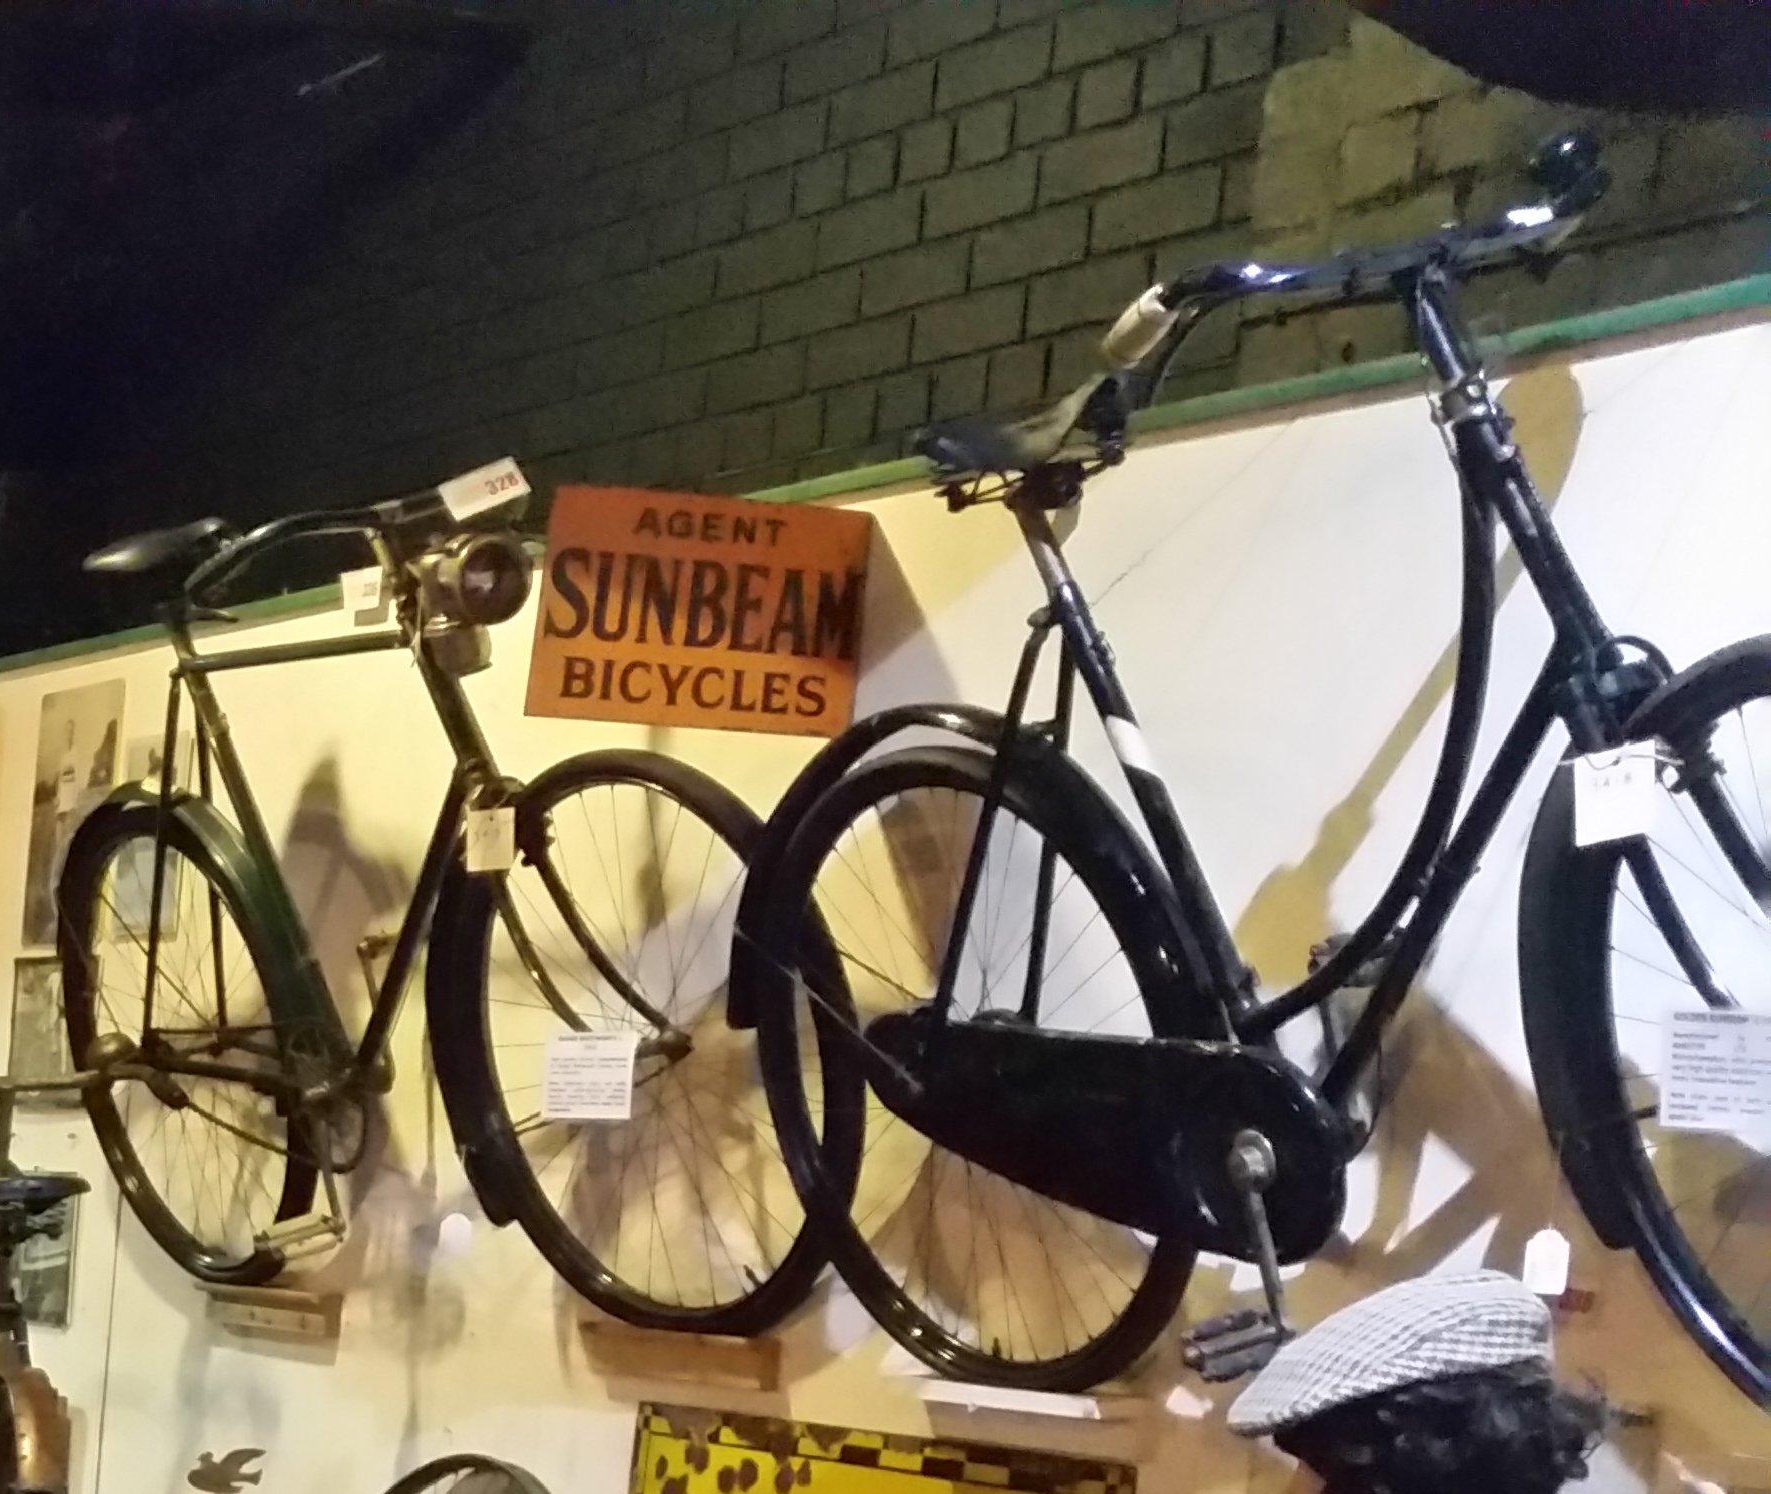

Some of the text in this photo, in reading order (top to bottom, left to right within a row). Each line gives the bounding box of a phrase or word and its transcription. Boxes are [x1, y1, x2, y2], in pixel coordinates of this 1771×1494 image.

[631, 506, 789, 547] AGENT
[543, 547, 866, 663] SUNBEAM
[559, 655, 827, 718] BICYCLES
